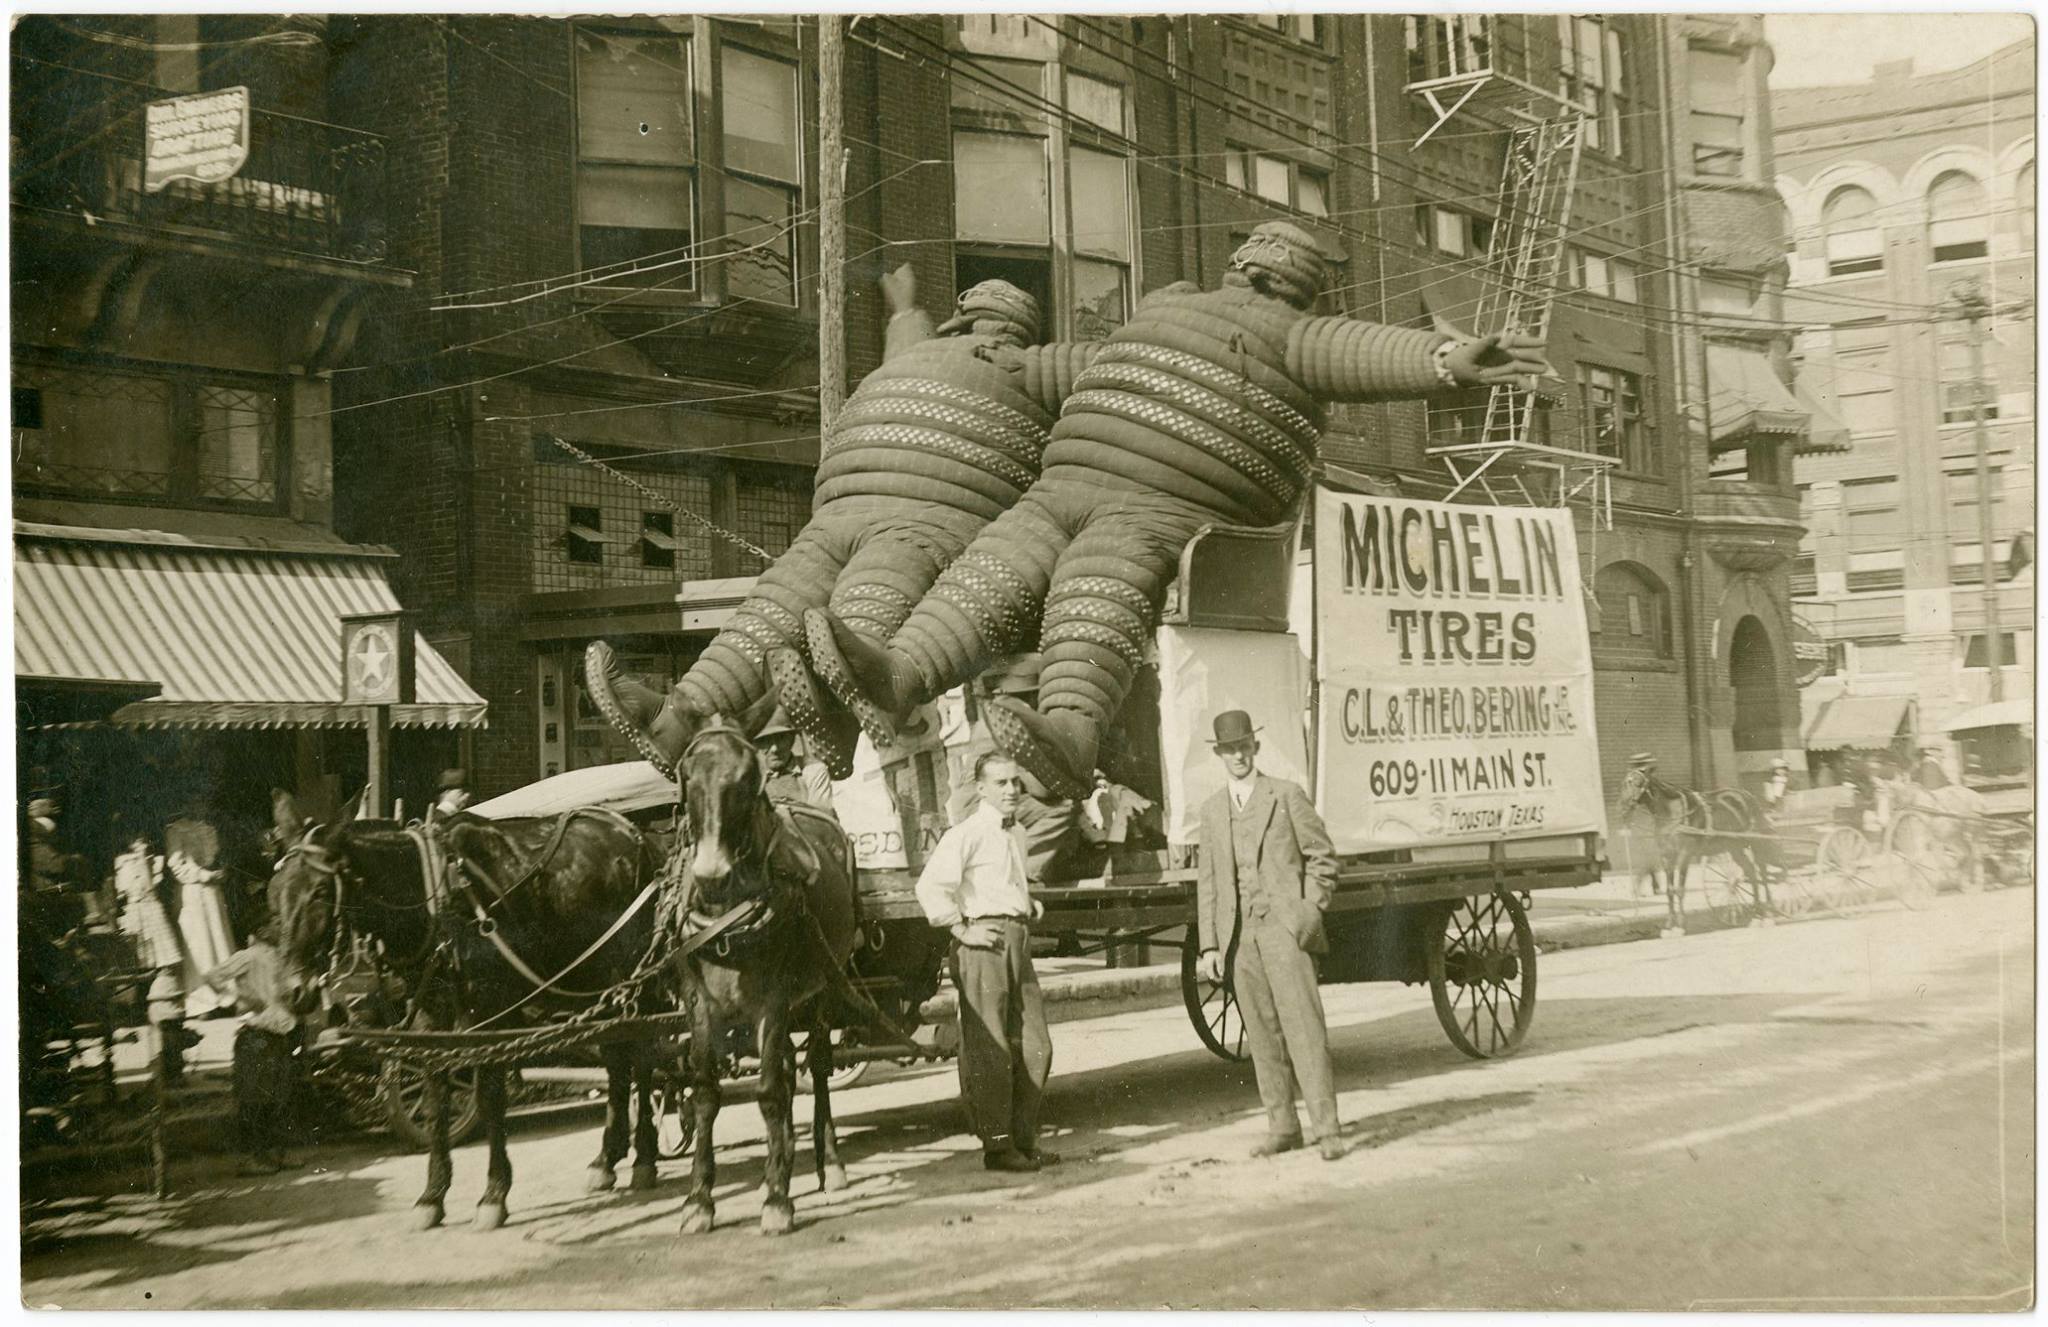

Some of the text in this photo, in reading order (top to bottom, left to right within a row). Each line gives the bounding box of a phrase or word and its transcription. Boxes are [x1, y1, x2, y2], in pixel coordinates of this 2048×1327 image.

[1342, 502, 1564, 600] MICHELIN
[1387, 608, 1537, 664] TIRES
[1387, 695, 1405, 738] &
[1470, 685, 1550, 736] BERING
[1450, 748, 1516, 792] MAIN
[1522, 751, 1552, 789] ST.
[1451, 803, 1545, 831] HOUSTON TEXAS
